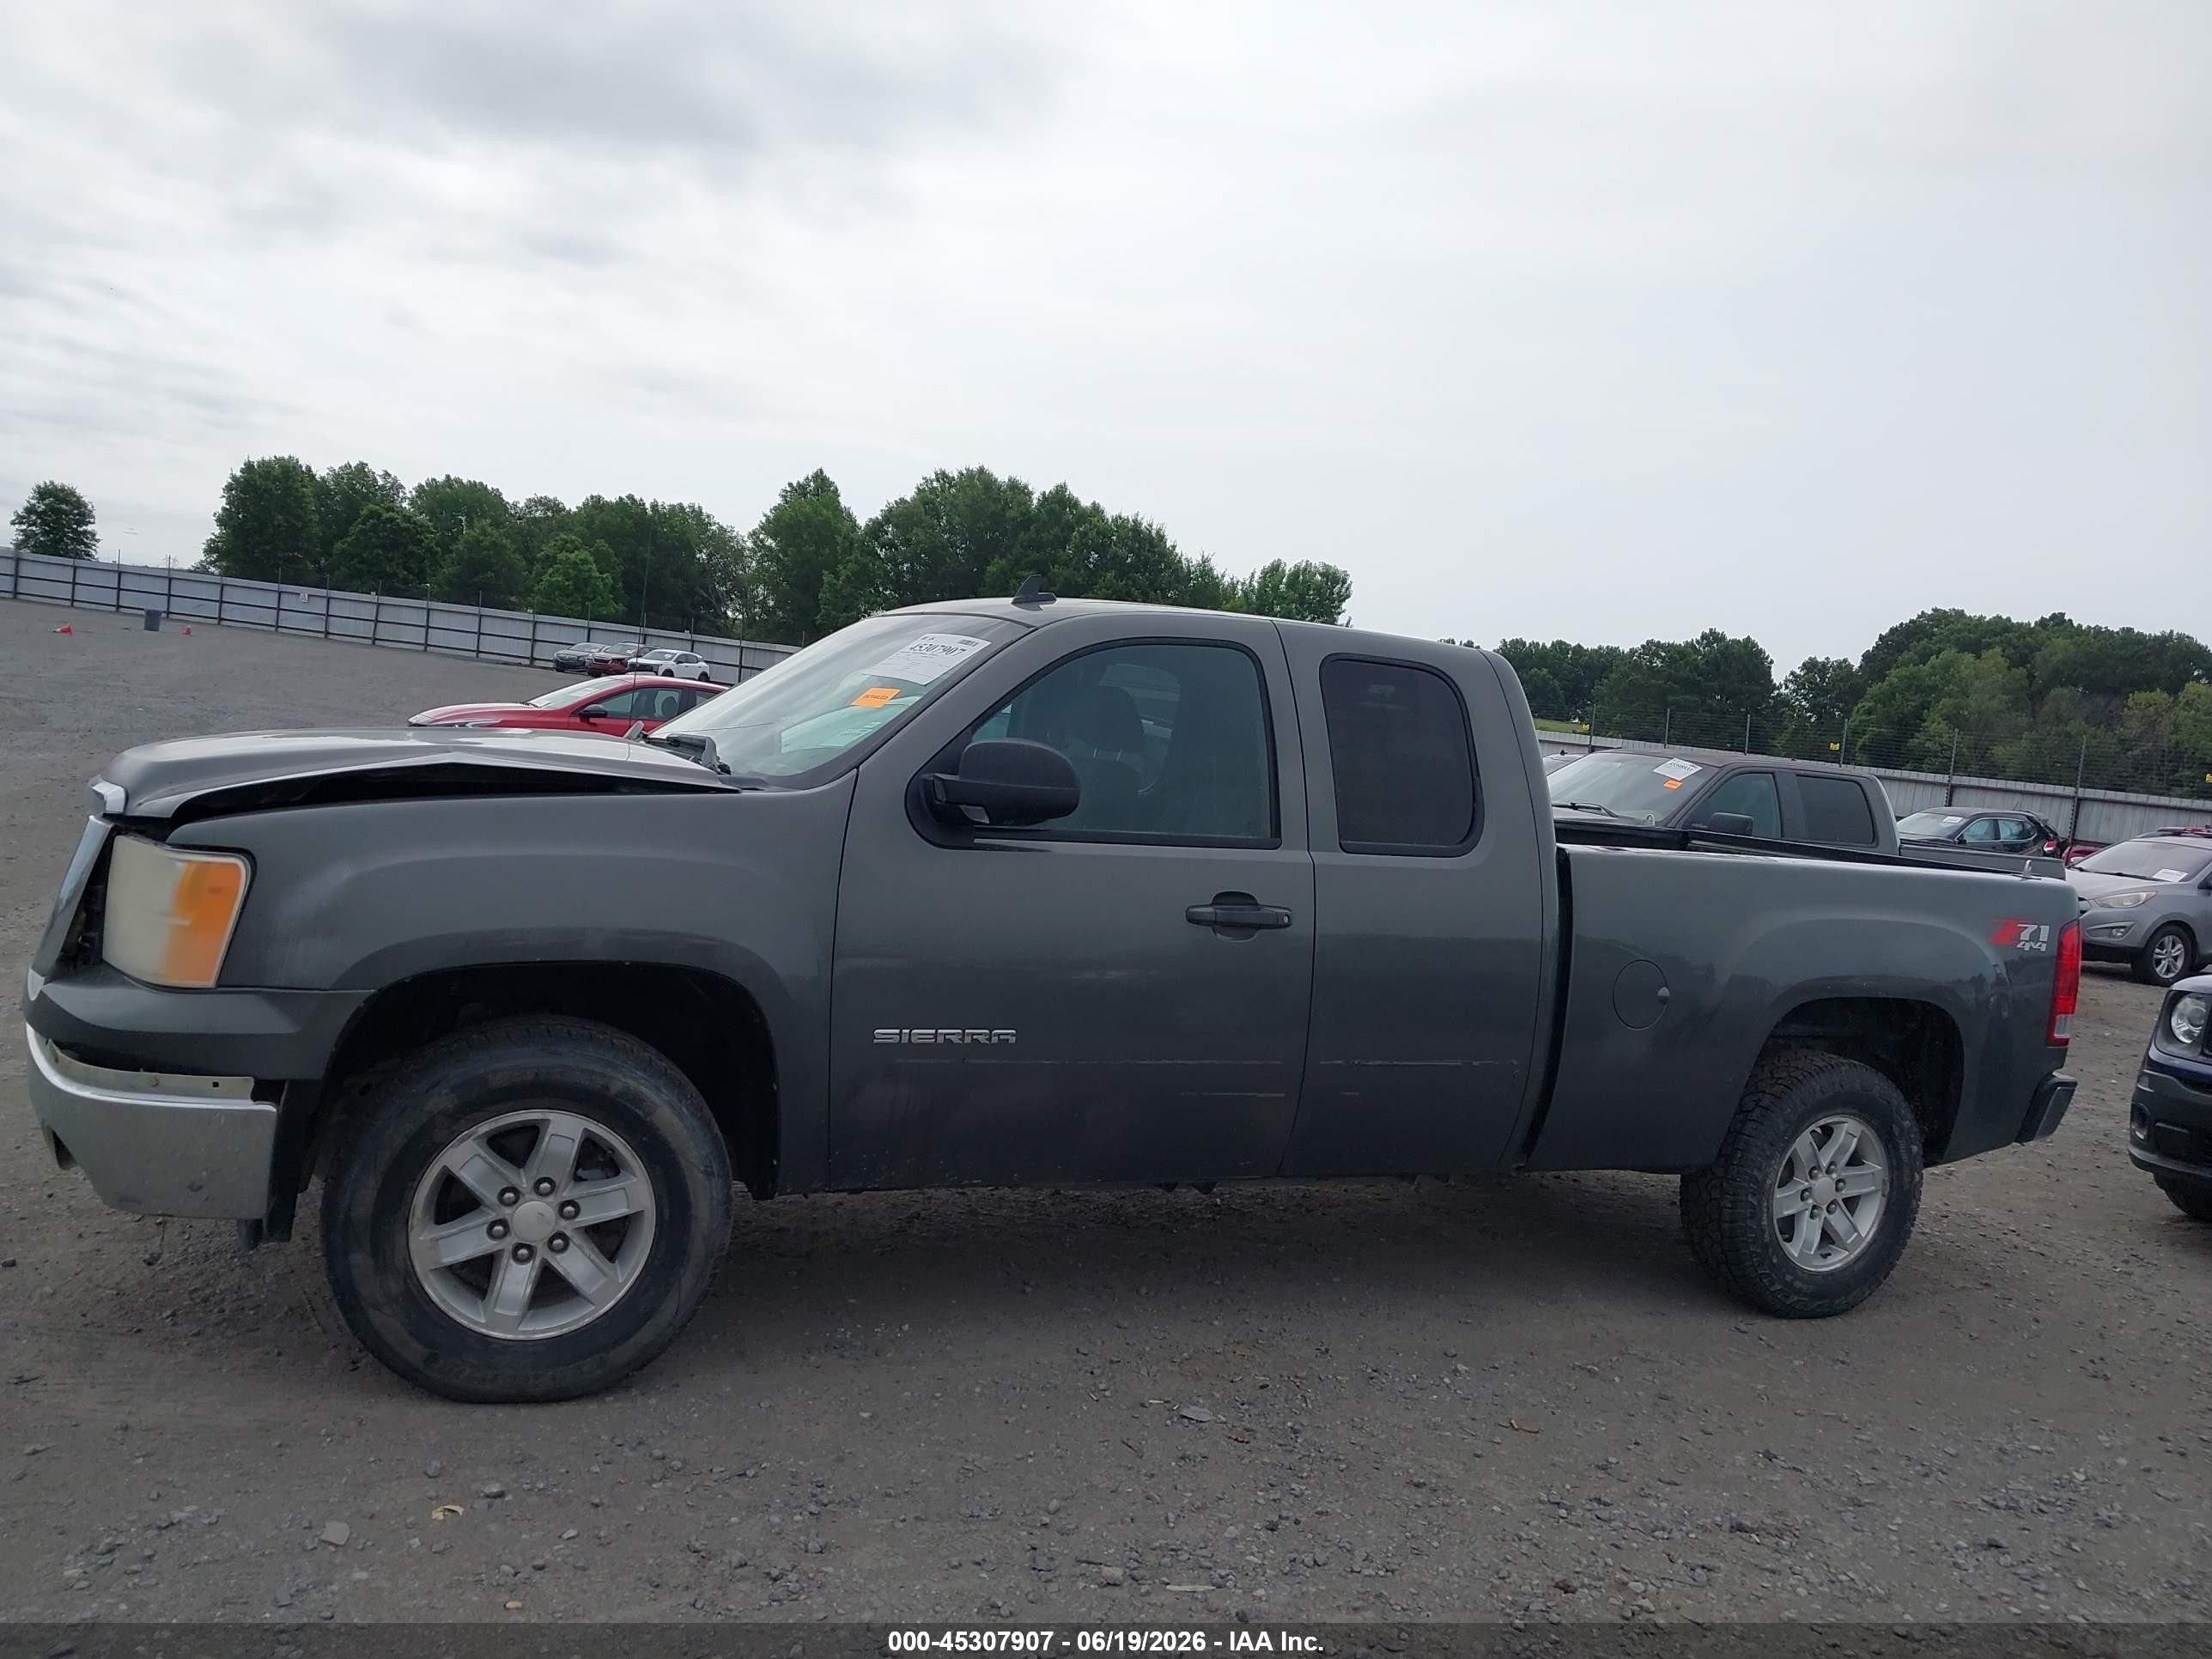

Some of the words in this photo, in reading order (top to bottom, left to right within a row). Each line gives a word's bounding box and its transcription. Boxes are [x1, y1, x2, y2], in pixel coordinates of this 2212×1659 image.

[909, 643, 967, 657] 45307907
[1990, 918, 2051, 945] Z71
[873, 1029, 1017, 1044] SIERRA
